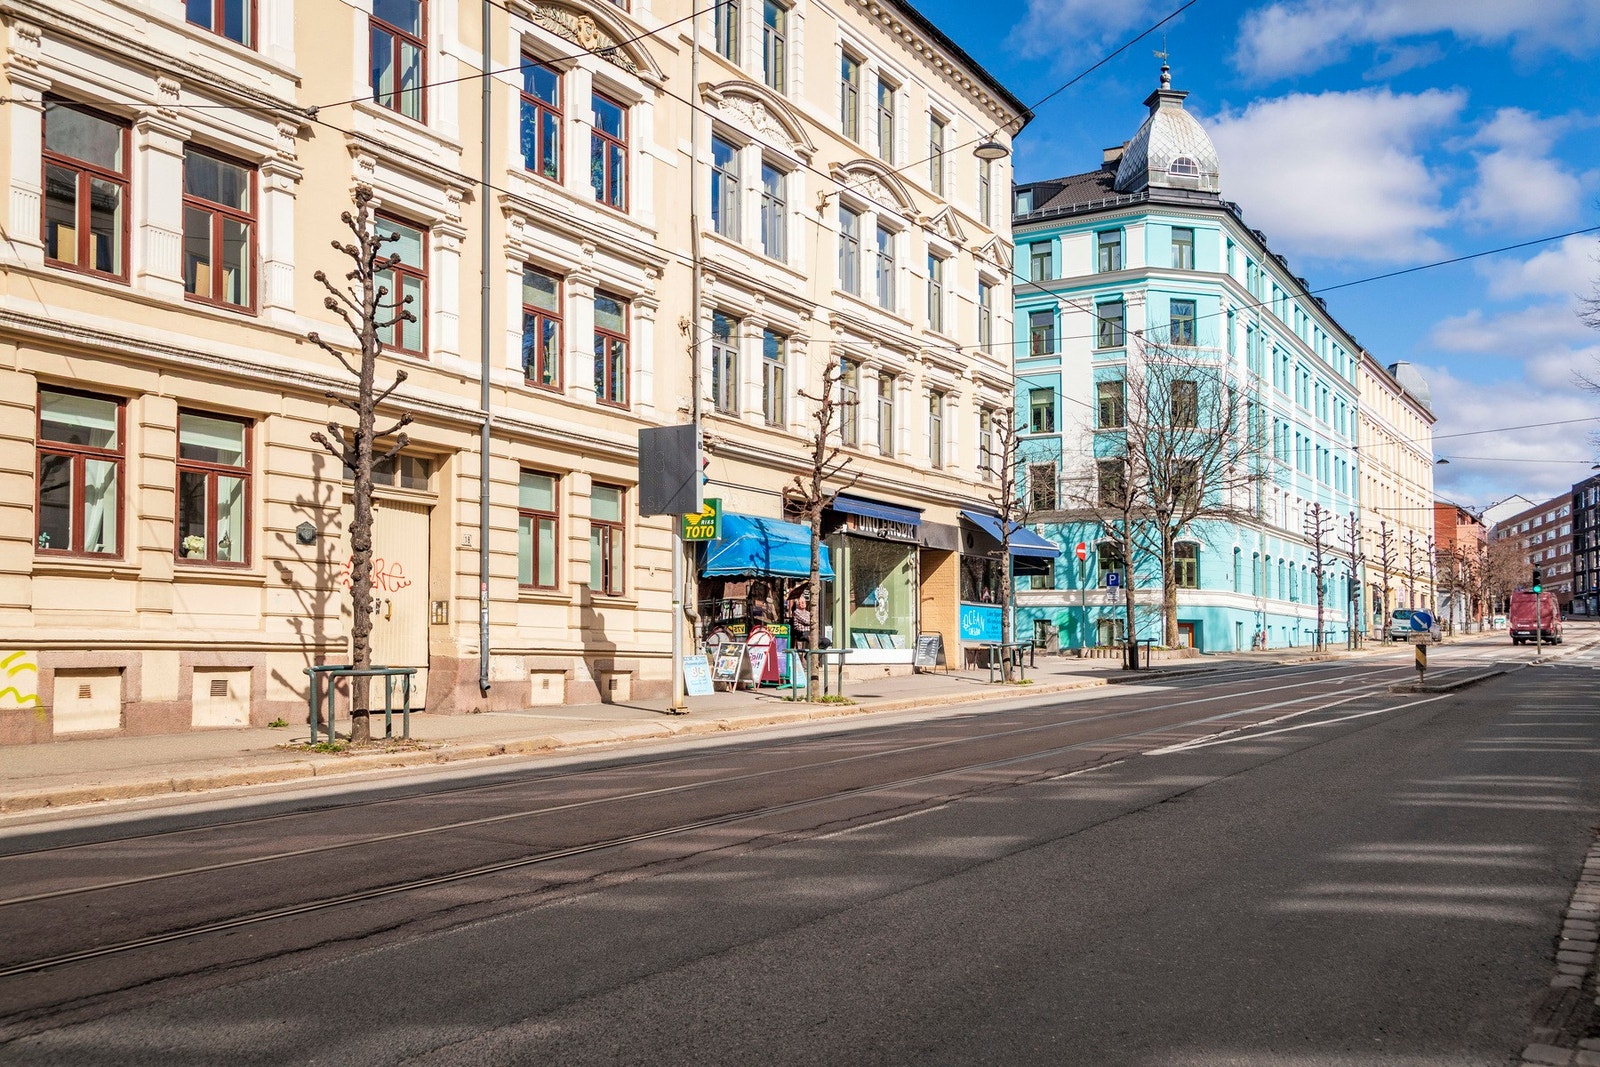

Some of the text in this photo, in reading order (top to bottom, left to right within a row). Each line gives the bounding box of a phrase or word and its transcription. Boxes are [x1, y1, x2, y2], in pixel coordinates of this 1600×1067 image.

[686, 525, 714, 538] TOTO
[1109, 574, 1116, 585] P
[963, 609, 985, 631] OCEAN
